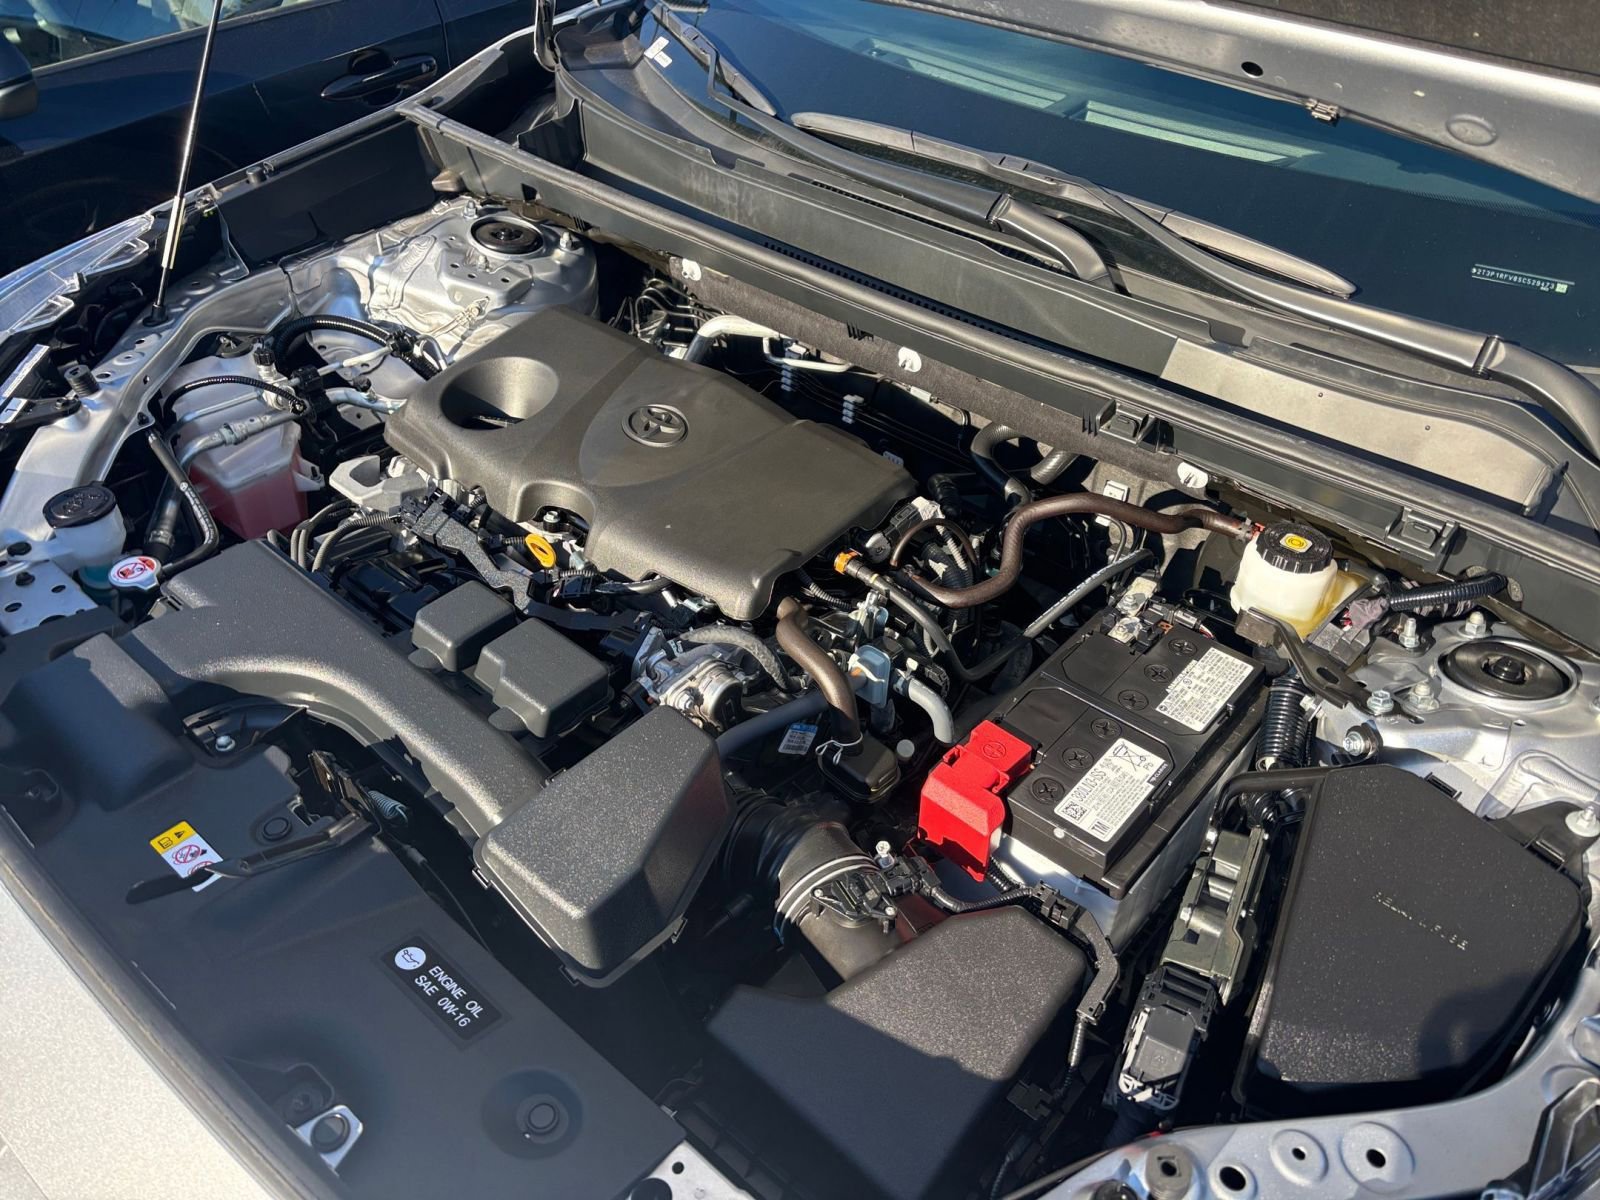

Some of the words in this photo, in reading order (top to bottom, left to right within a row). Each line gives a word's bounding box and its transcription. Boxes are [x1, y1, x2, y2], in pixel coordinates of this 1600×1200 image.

[1091, 821, 1111, 836] TM
[414, 975, 440, 996] SAE
[437, 997, 471, 1027] 0W-16
[428, 966, 467, 1000] ENGINE
[465, 1000, 483, 1019] OIL
